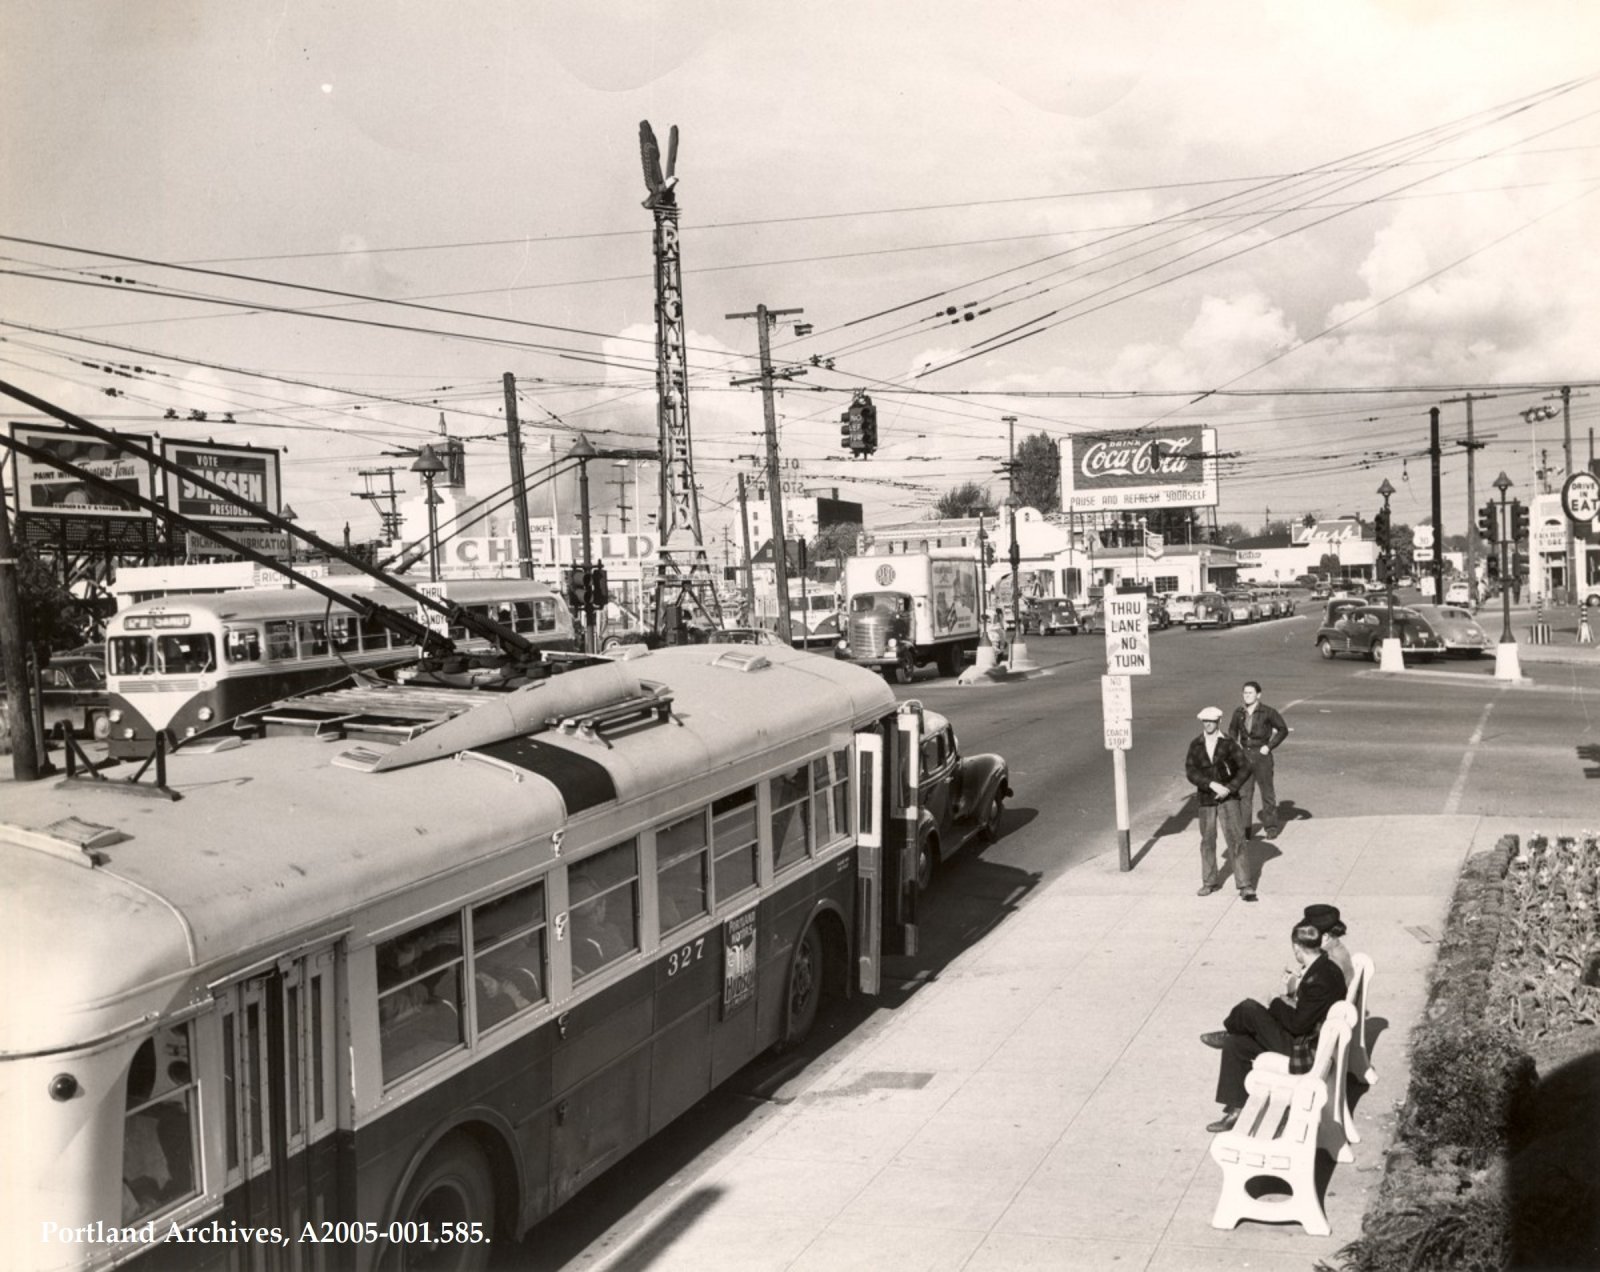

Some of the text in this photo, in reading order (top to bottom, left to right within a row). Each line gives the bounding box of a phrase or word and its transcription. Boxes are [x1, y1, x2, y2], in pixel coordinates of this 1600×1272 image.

[1109, 440, 1141, 448] DRINK
[196, 455, 219, 467] VOTE
[33, 471, 54, 480] PAINT
[1070, 489, 1207, 507] PAUSE AND REFRESH YOURSELF
[1571, 499, 1599, 512] EAT
[421, 587, 442, 598] THRU
[1110, 601, 1141, 615] THRU
[1111, 619, 1141, 632] LANE
[1121, 636, 1137, 650] NO
[1114, 654, 1145, 668] TURN
[1106, 728, 1129, 737] COACH
[1108, 738, 1127, 746] STOP
[667, 937, 705, 976] 327
